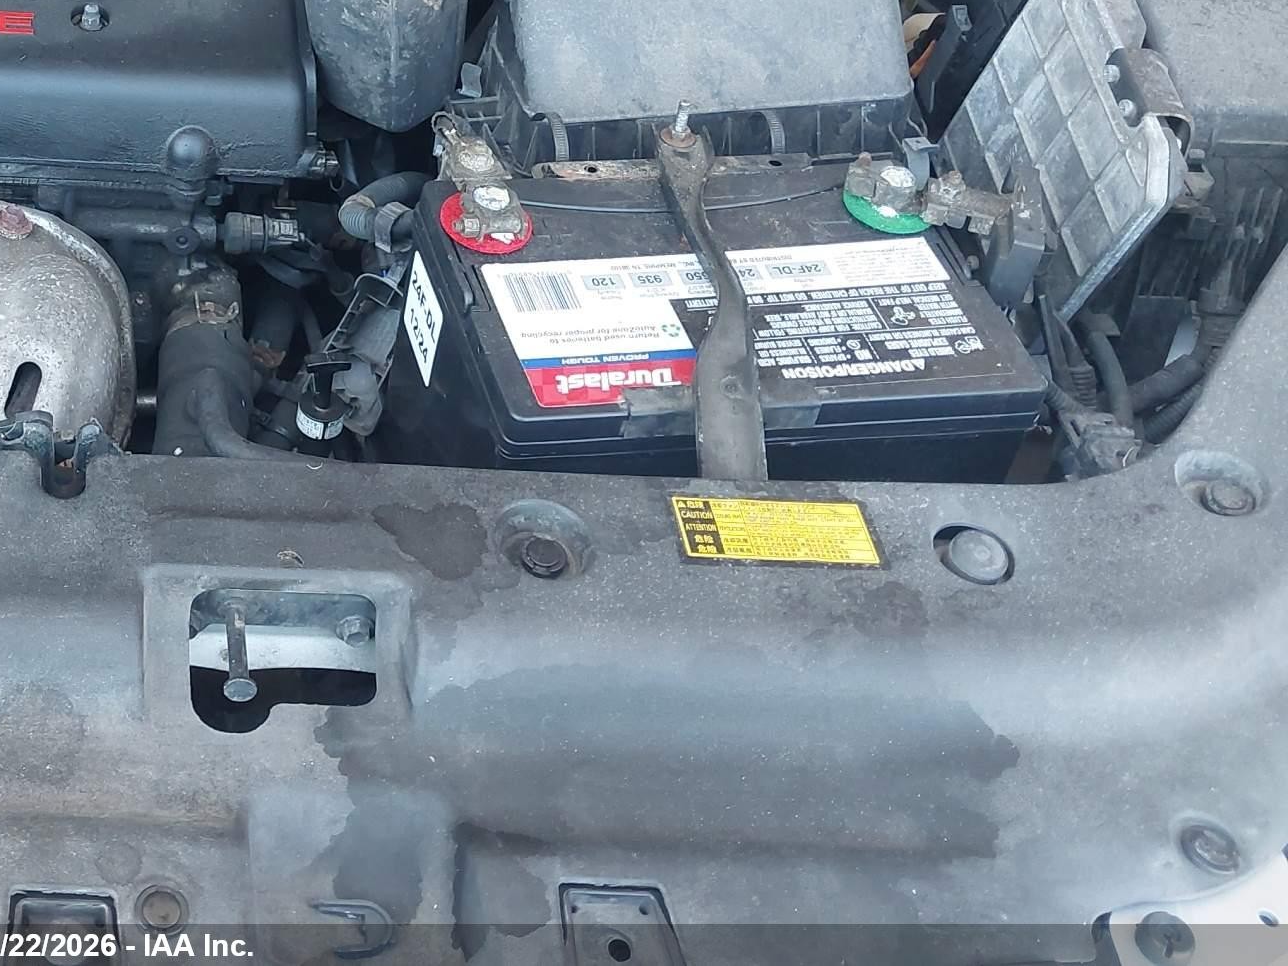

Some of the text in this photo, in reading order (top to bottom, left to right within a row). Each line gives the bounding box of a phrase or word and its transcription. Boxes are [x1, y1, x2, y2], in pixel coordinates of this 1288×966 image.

[772, 264, 822, 276] 24F-DL
[591, 277, 617, 286] 120
[637, 274, 663, 284] 935
[412, 270, 436, 345] 24F-DL
[410, 308, 428, 364] 12/24
[562, 353, 649, 364] PROVEN TOUGH
[854, 349, 872, 359] NO
[781, 359, 915, 379] DANGER/POISON
[554, 367, 683, 394] Duralast
[681, 510, 713, 519] CAUTION
[685, 523, 718, 532] ATTENTION
